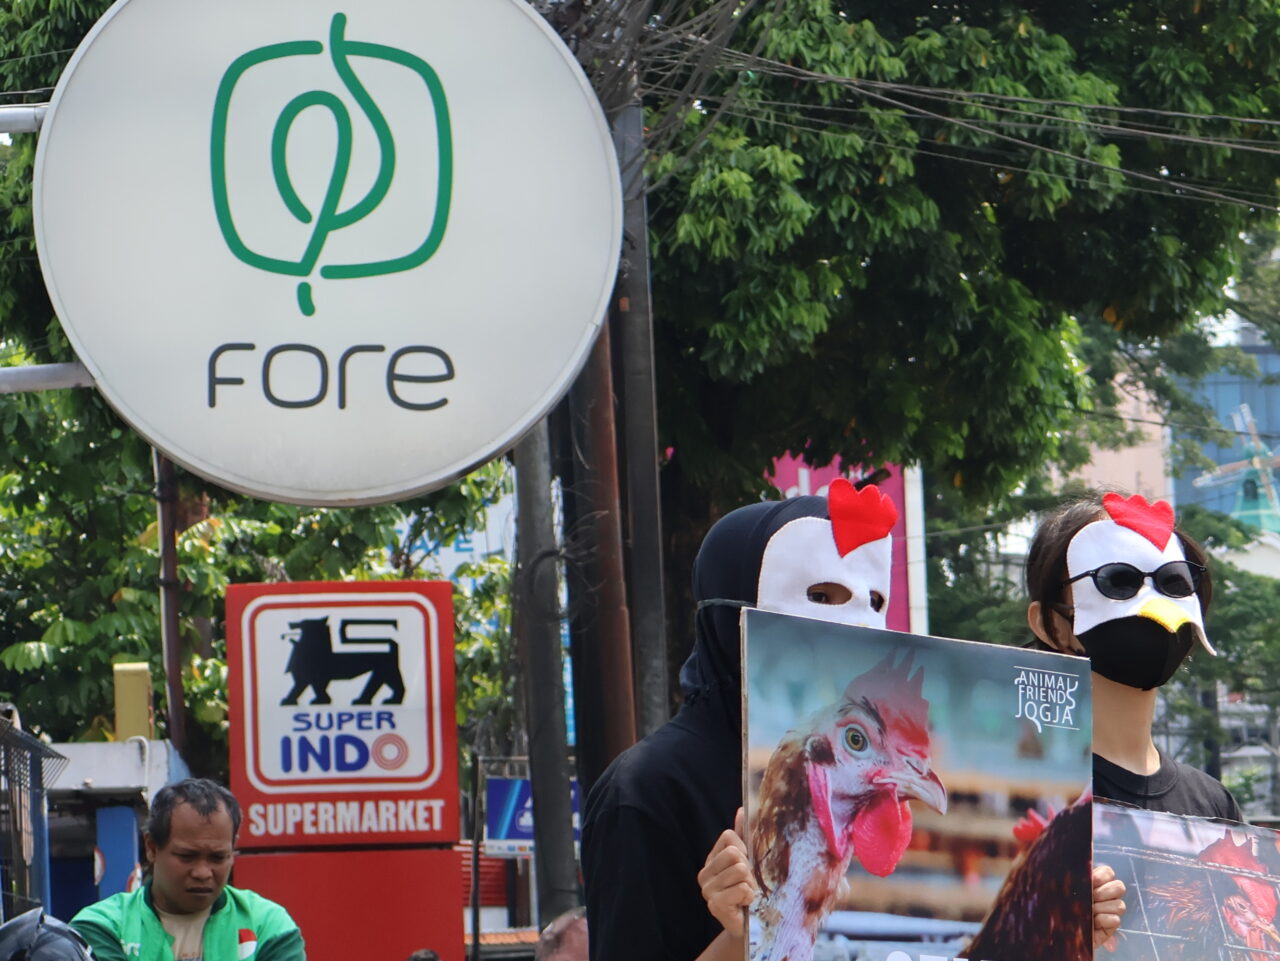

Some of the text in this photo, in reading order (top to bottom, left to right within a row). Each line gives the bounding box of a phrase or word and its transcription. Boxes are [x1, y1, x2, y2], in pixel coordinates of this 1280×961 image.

[1014, 671, 1078, 691] ANIMAL
[1018, 684, 1076, 709] FRIENDS
[292, 711, 396, 731] SUPER
[280, 733, 409, 773] INDO
[249, 799, 445, 836] SUPERMARKET
